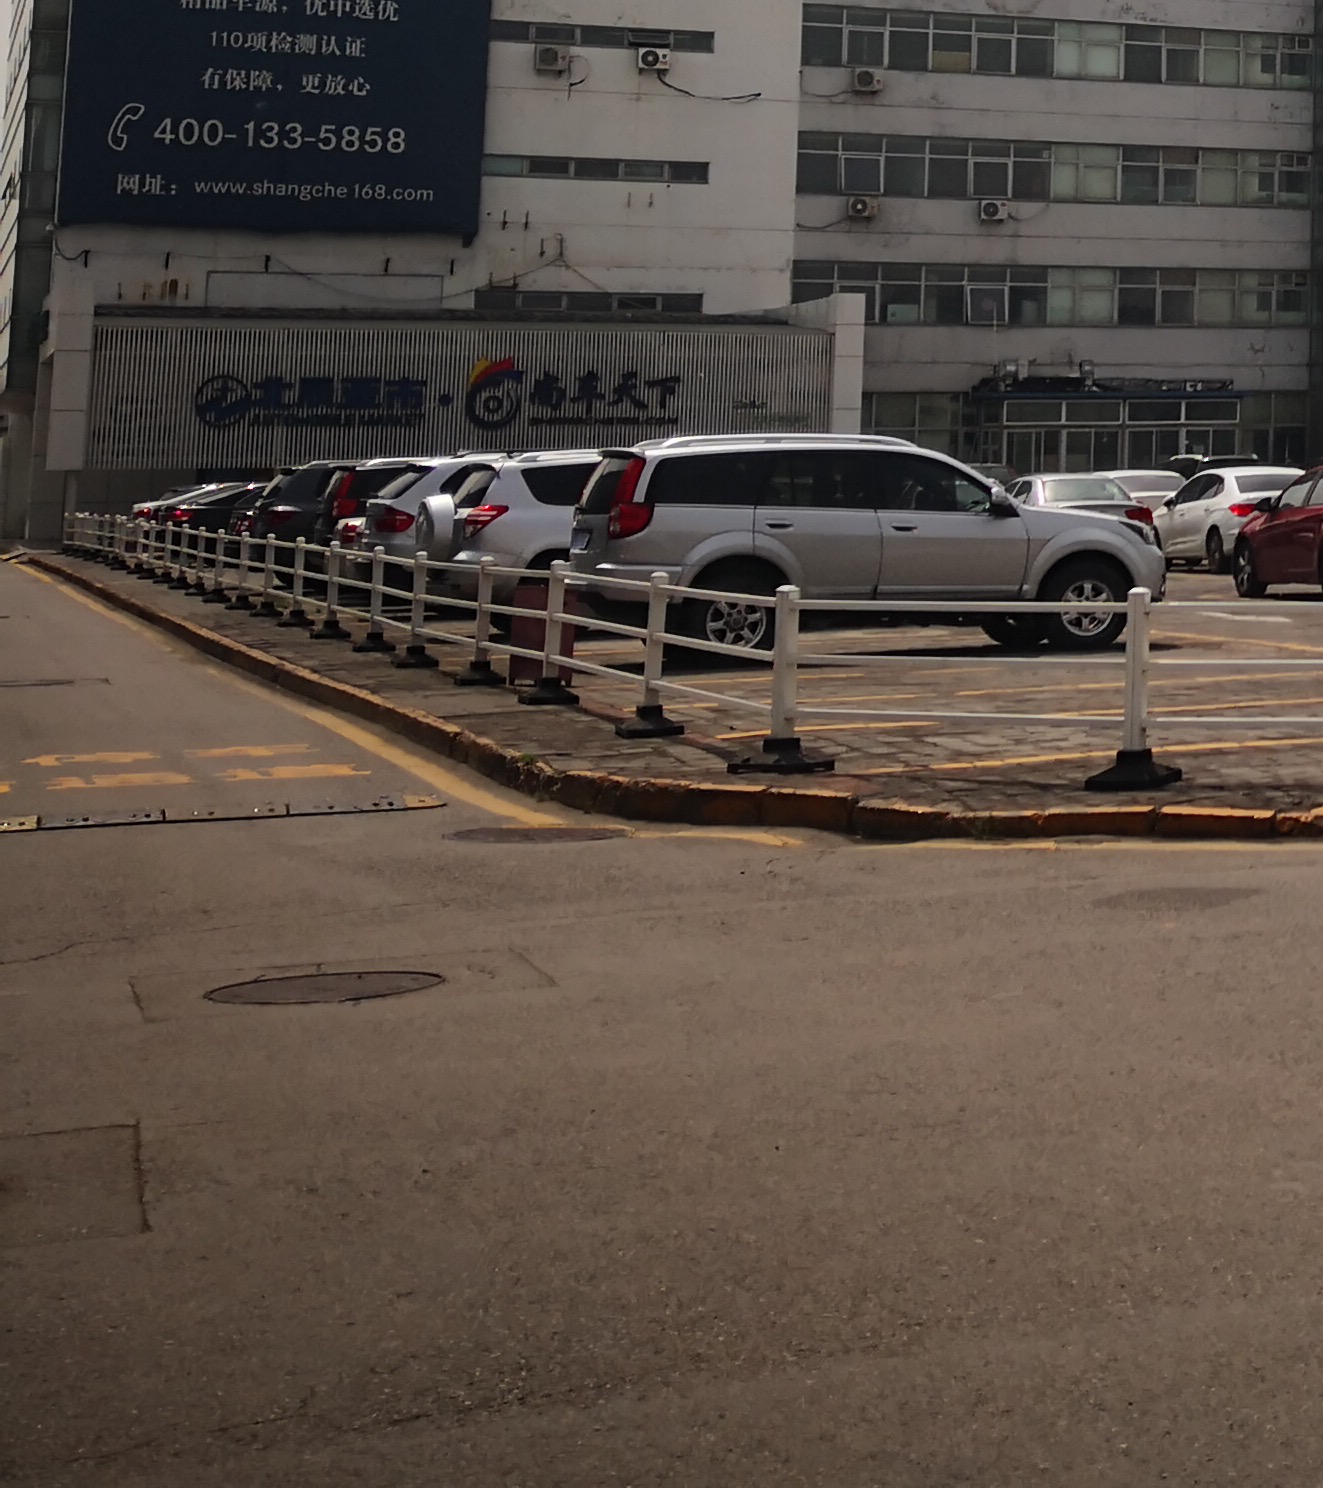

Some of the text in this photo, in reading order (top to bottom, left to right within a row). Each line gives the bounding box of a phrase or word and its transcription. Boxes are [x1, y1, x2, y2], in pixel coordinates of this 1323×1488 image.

[209, 30, 367, 59] 110项检测认证
[200, 67, 371, 97] 有保障，更放心
[153, 116, 407, 155] 400-133-5858
[193, 177, 434, 204] www.shangche168.com
